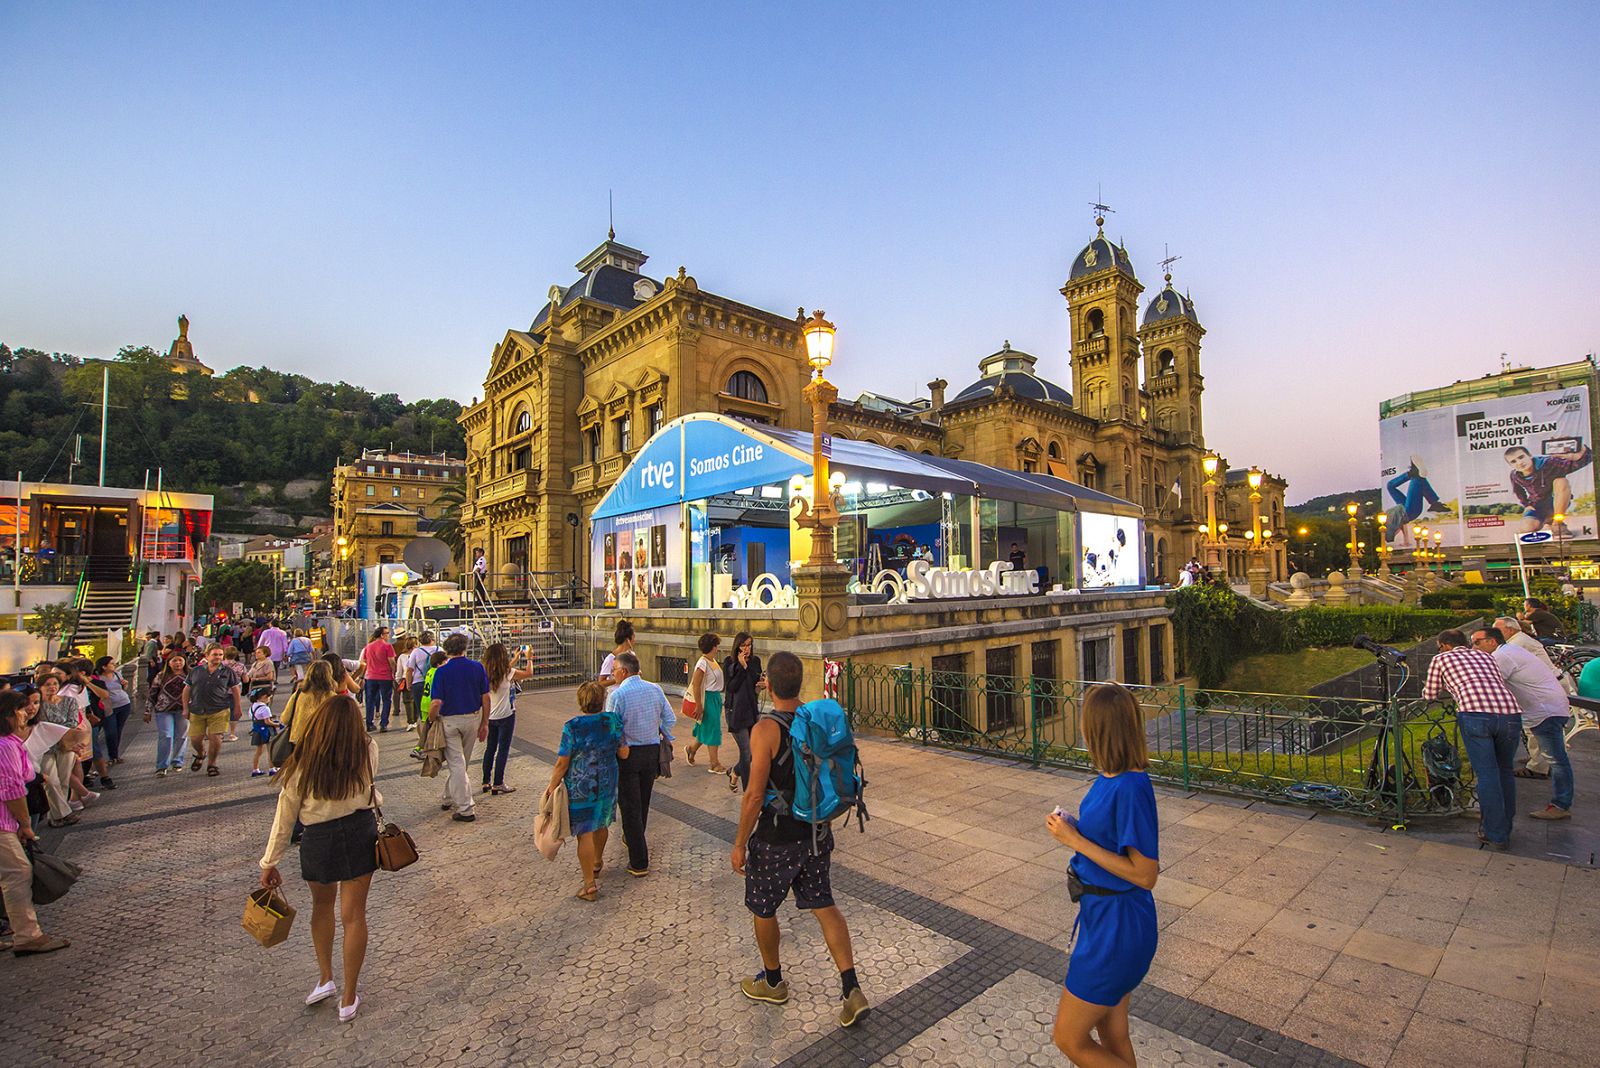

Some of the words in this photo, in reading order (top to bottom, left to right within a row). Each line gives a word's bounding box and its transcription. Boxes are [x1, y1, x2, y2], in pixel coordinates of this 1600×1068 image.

[1469, 415, 1531, 431] DEN-DENA
[1469, 422, 1557, 441] MUGIKORREAN
[1470, 440, 1498, 451] NAHI
[1501, 436, 1525, 447] DUT
[690, 456, 729, 477] Somos
[732, 444, 763, 467] Cine
[641, 460, 674, 489] rtve
